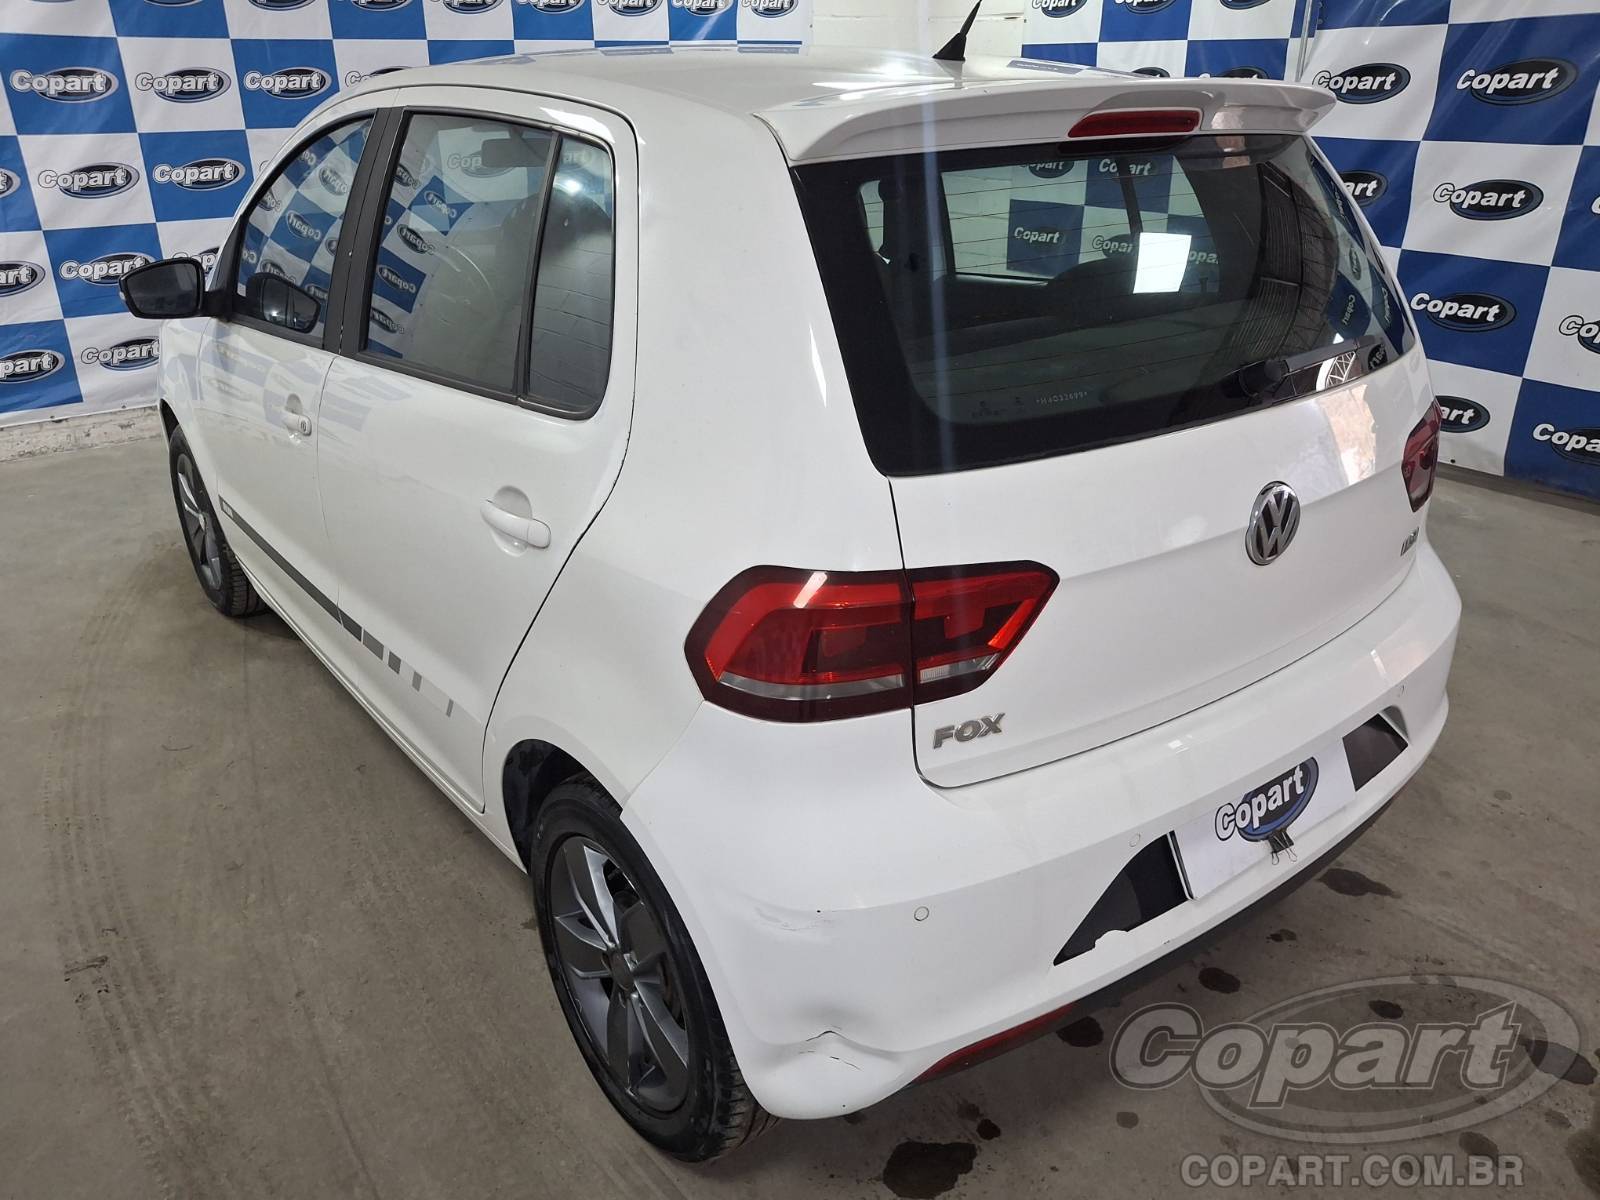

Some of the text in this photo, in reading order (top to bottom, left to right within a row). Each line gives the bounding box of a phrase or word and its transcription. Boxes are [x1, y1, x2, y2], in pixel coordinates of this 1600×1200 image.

[10, 70, 107, 94] Copart
[135, 70, 219, 94] Copart
[243, 70, 322, 93] Copart
[1312, 70, 1396, 93] Copart
[1457, 68, 1559, 94] Copart
[154, 161, 235, 185] Copart
[448, 153, 483, 171] Cop
[1099, 159, 1151, 176] Coart
[38, 166, 128, 191] Copart
[1345, 179, 1378, 197] art
[1433, 183, 1527, 209] Copart
[1014, 227, 1061, 243] Copart
[1092, 235, 1133, 254] Copar
[0, 265, 32, 285] art
[1410, 293, 1500, 322] Copart
[0, 352, 54, 379] part
[1440, 406, 1475, 425] art
[1532, 423, 1600, 451] Copa
[932, 712, 1005, 750] FOX
[1215, 764, 1304, 841] Copart
